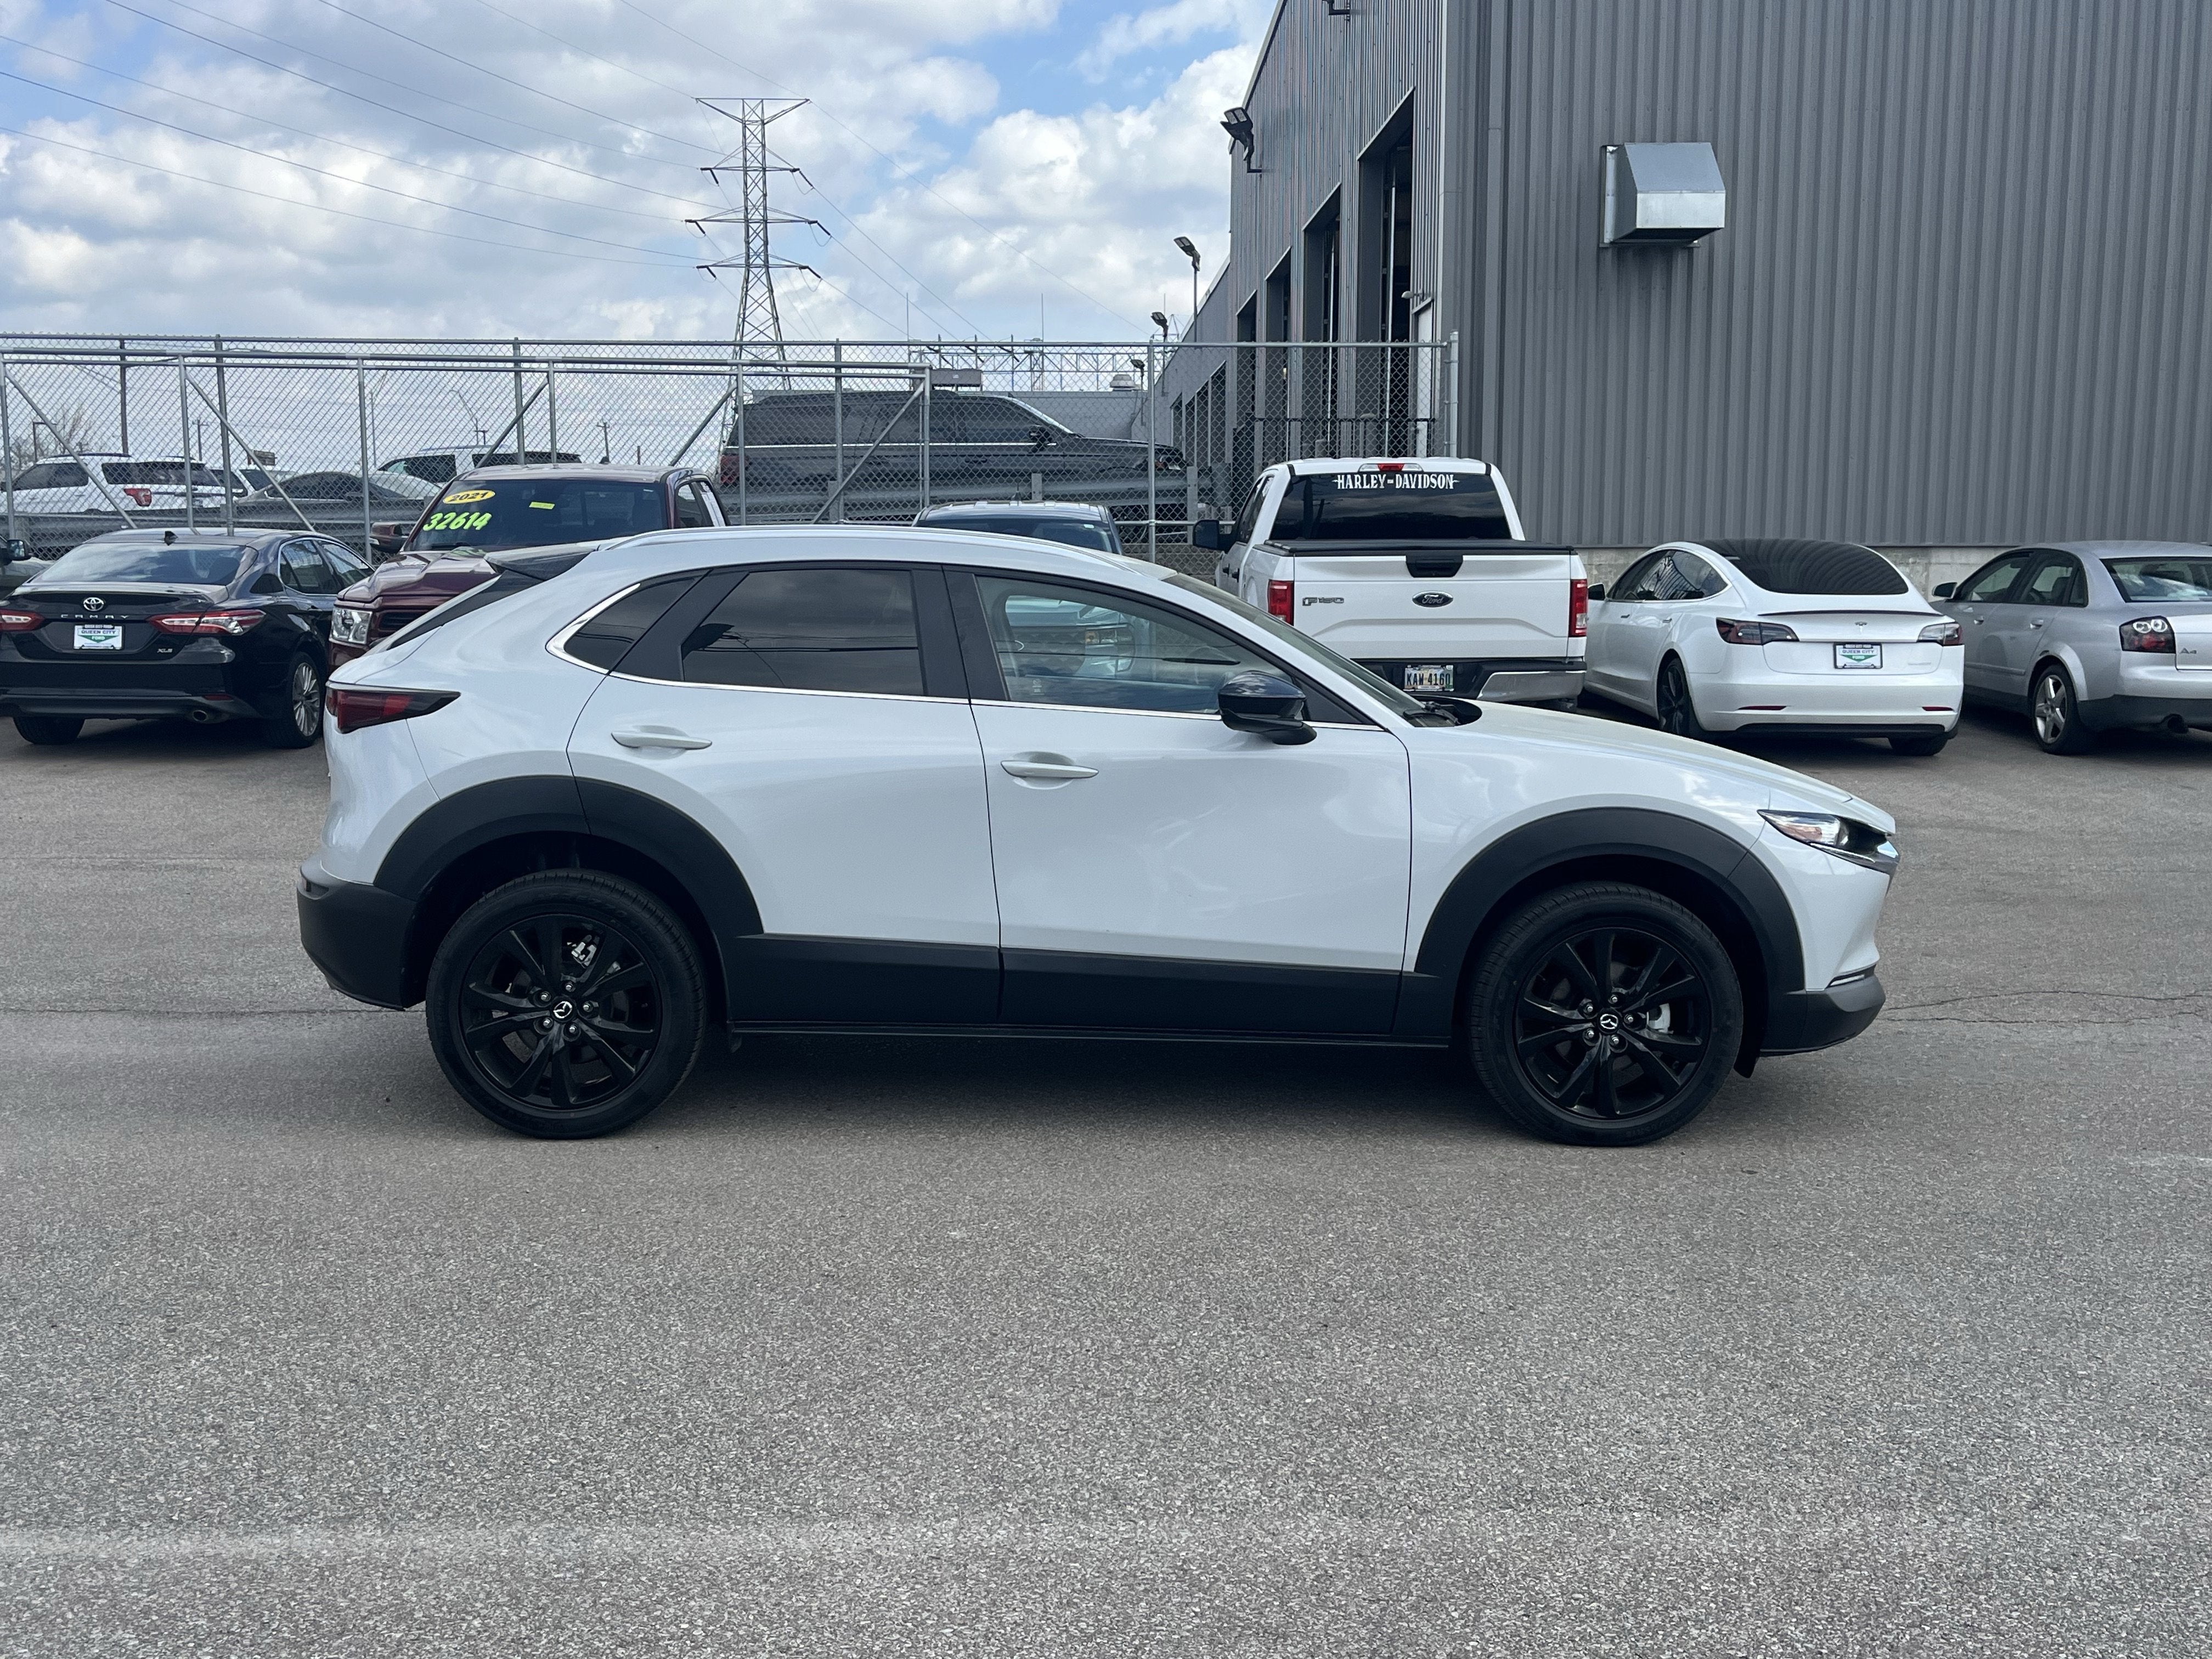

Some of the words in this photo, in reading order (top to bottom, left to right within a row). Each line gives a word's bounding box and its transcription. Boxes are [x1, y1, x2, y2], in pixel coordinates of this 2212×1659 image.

[1337, 473, 1454, 489] HARLEY-DAVIDSON
[448, 492, 489, 502] 2021
[422, 512, 492, 532] 32614
[1422, 594, 1444, 604] Ford
[1427, 673, 1451, 686] 4160
